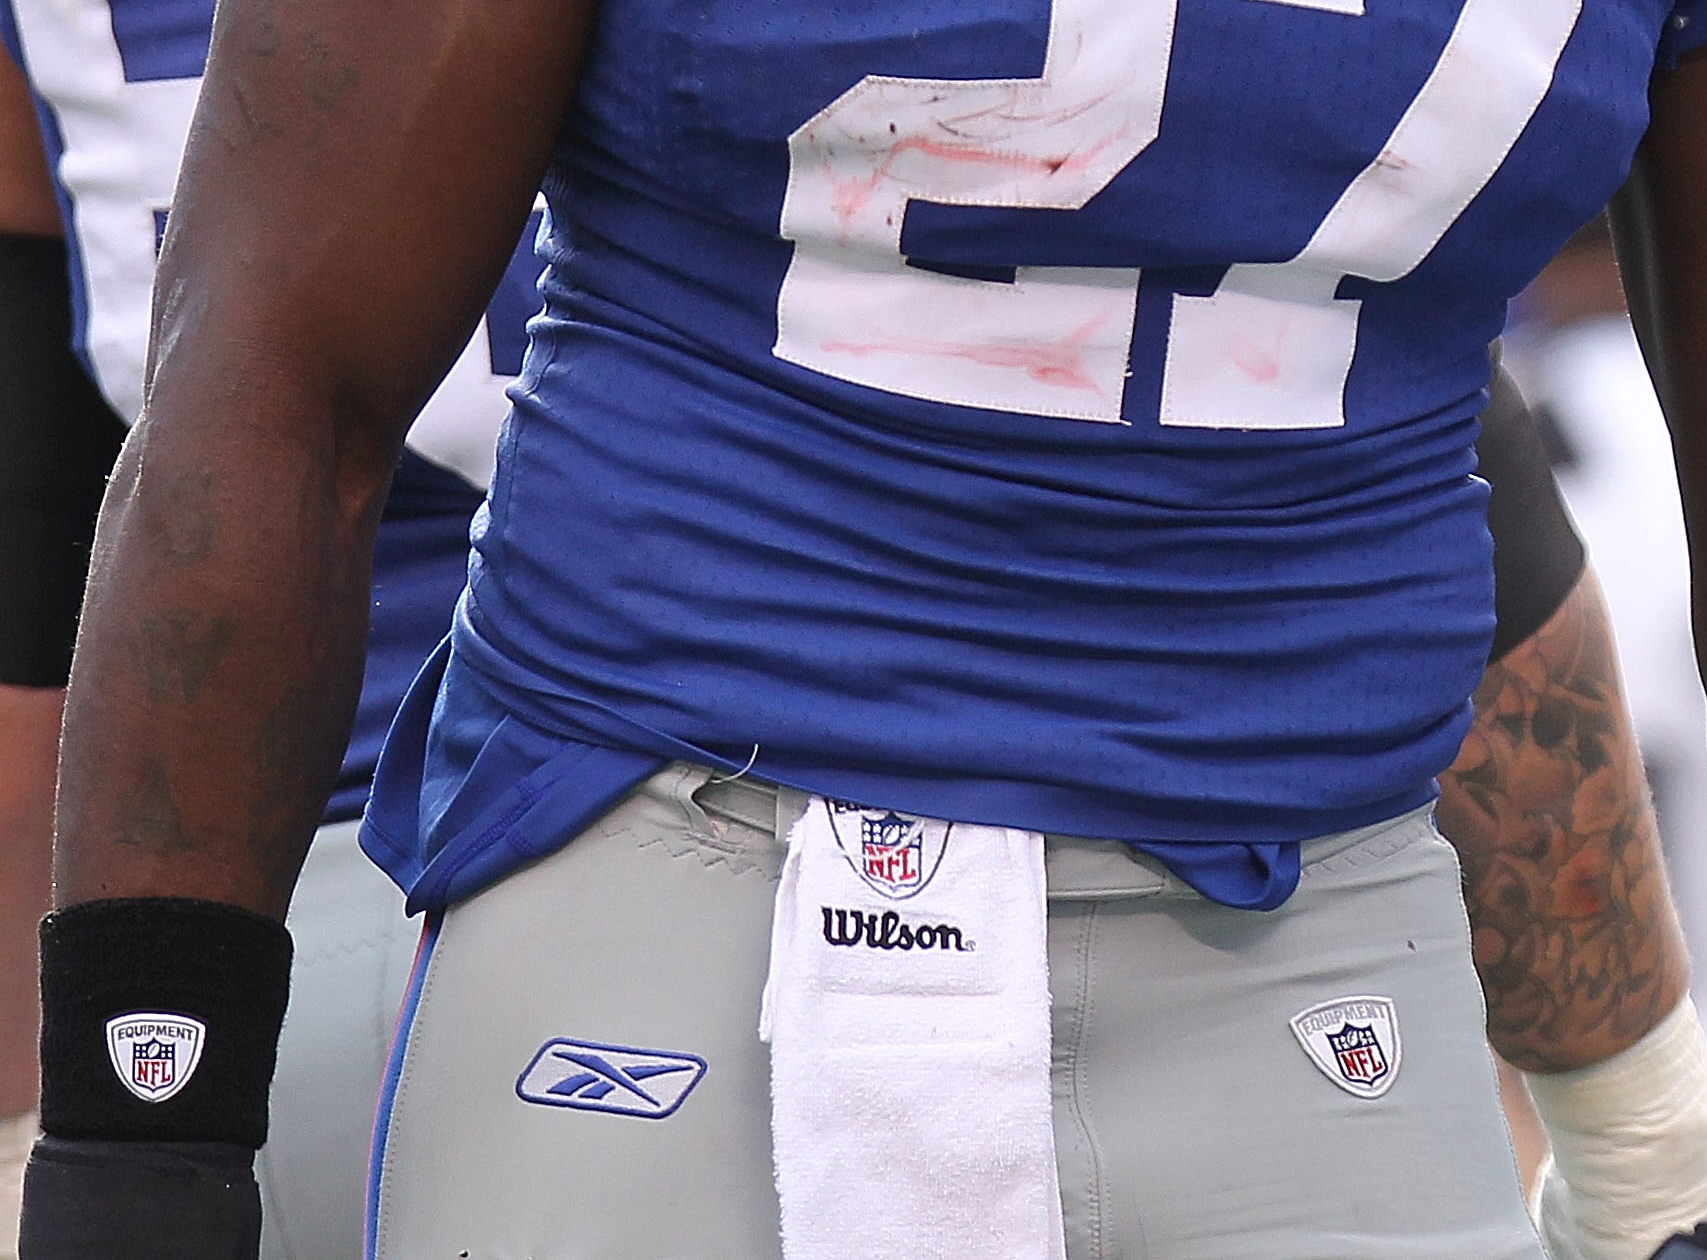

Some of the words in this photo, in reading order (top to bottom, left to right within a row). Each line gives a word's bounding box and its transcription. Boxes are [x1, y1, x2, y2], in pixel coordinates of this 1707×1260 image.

[865, 844, 917, 884] NFL
[821, 905, 967, 952] Wilson
[117, 1024, 194, 1041] EQUIPMENT
[1302, 1002, 1386, 1037] EQUIPMENT
[136, 1060, 171, 1087] NFL
[1340, 1046, 1384, 1079] NFL
